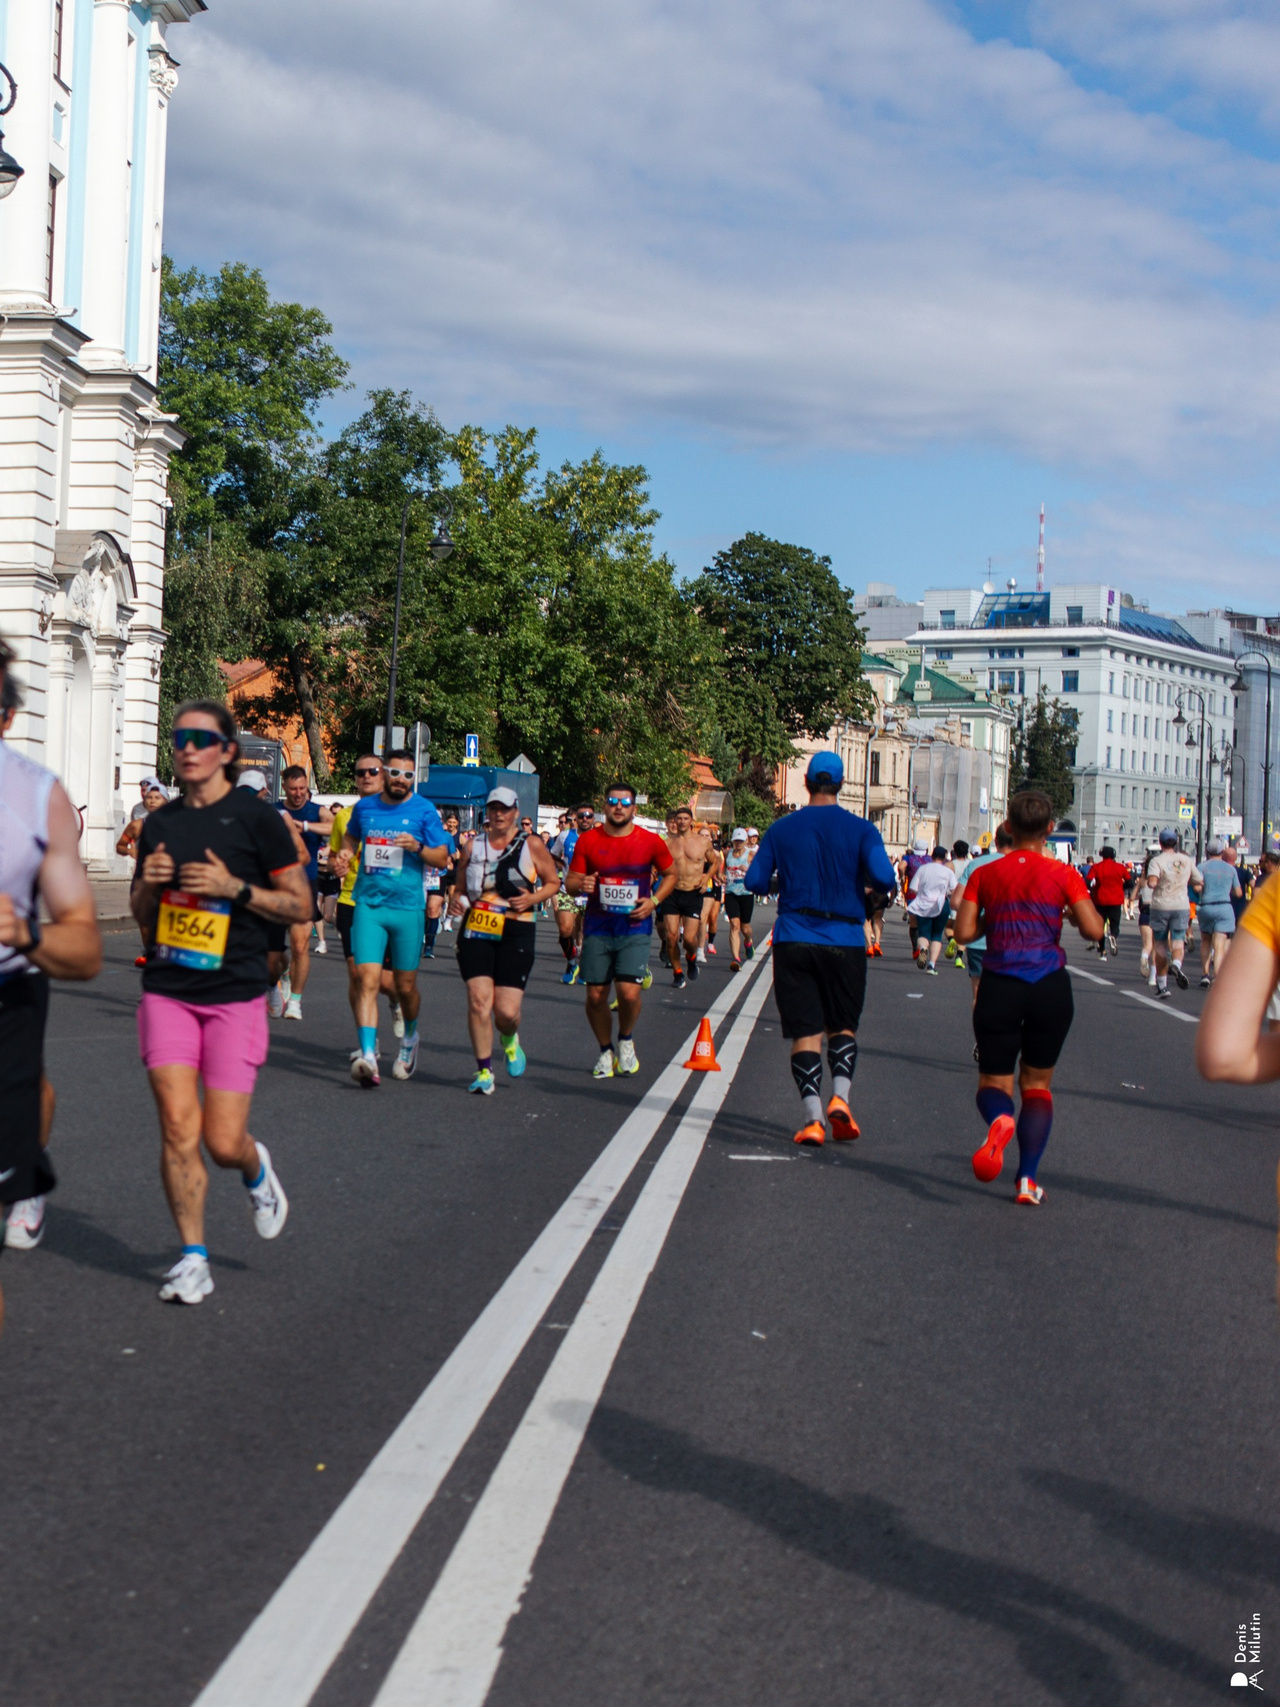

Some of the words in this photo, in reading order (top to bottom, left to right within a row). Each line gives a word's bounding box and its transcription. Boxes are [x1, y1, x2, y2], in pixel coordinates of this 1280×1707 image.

[375, 848, 389, 860] 84
[604, 887, 633, 900] 5056
[167, 910, 215, 940] 1564
